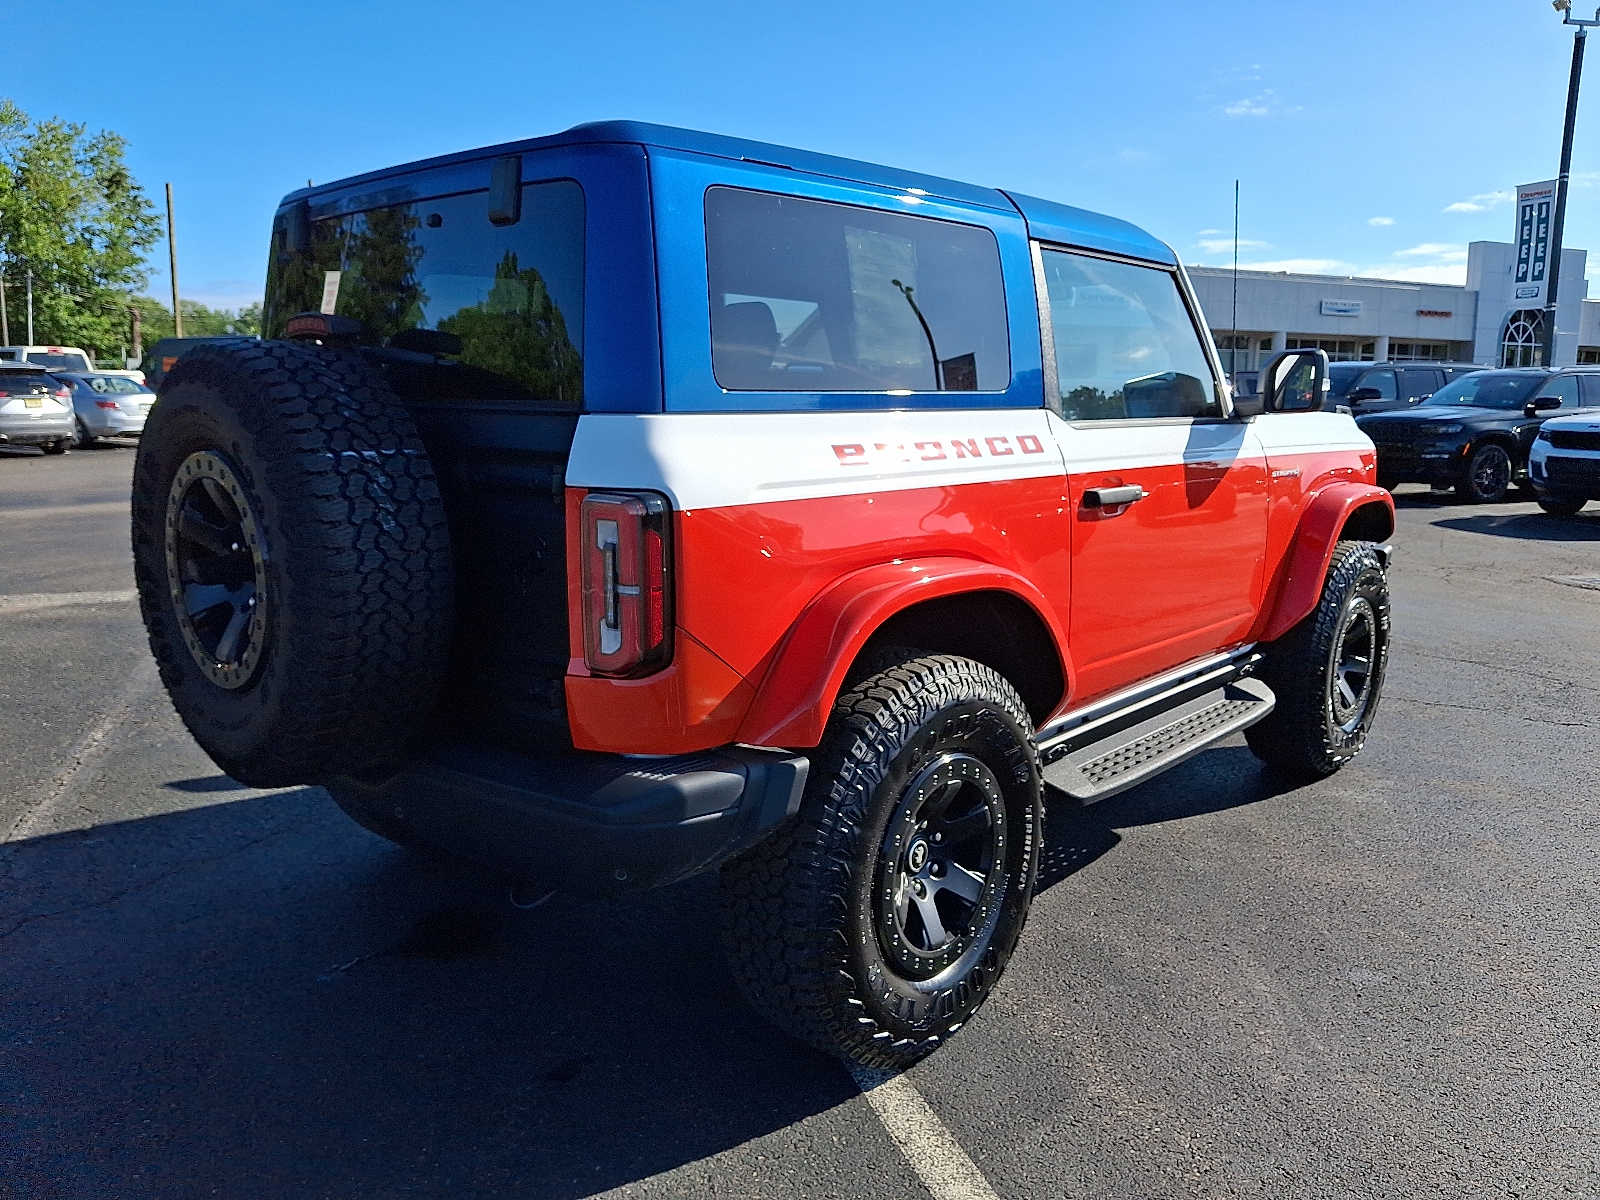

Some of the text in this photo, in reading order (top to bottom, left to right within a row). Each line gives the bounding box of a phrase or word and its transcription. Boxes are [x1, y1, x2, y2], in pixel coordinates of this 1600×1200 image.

[1517, 205, 1531, 278] JEEP
[1533, 203, 1548, 277] JEEP
[831, 435, 1044, 465] BONCO
